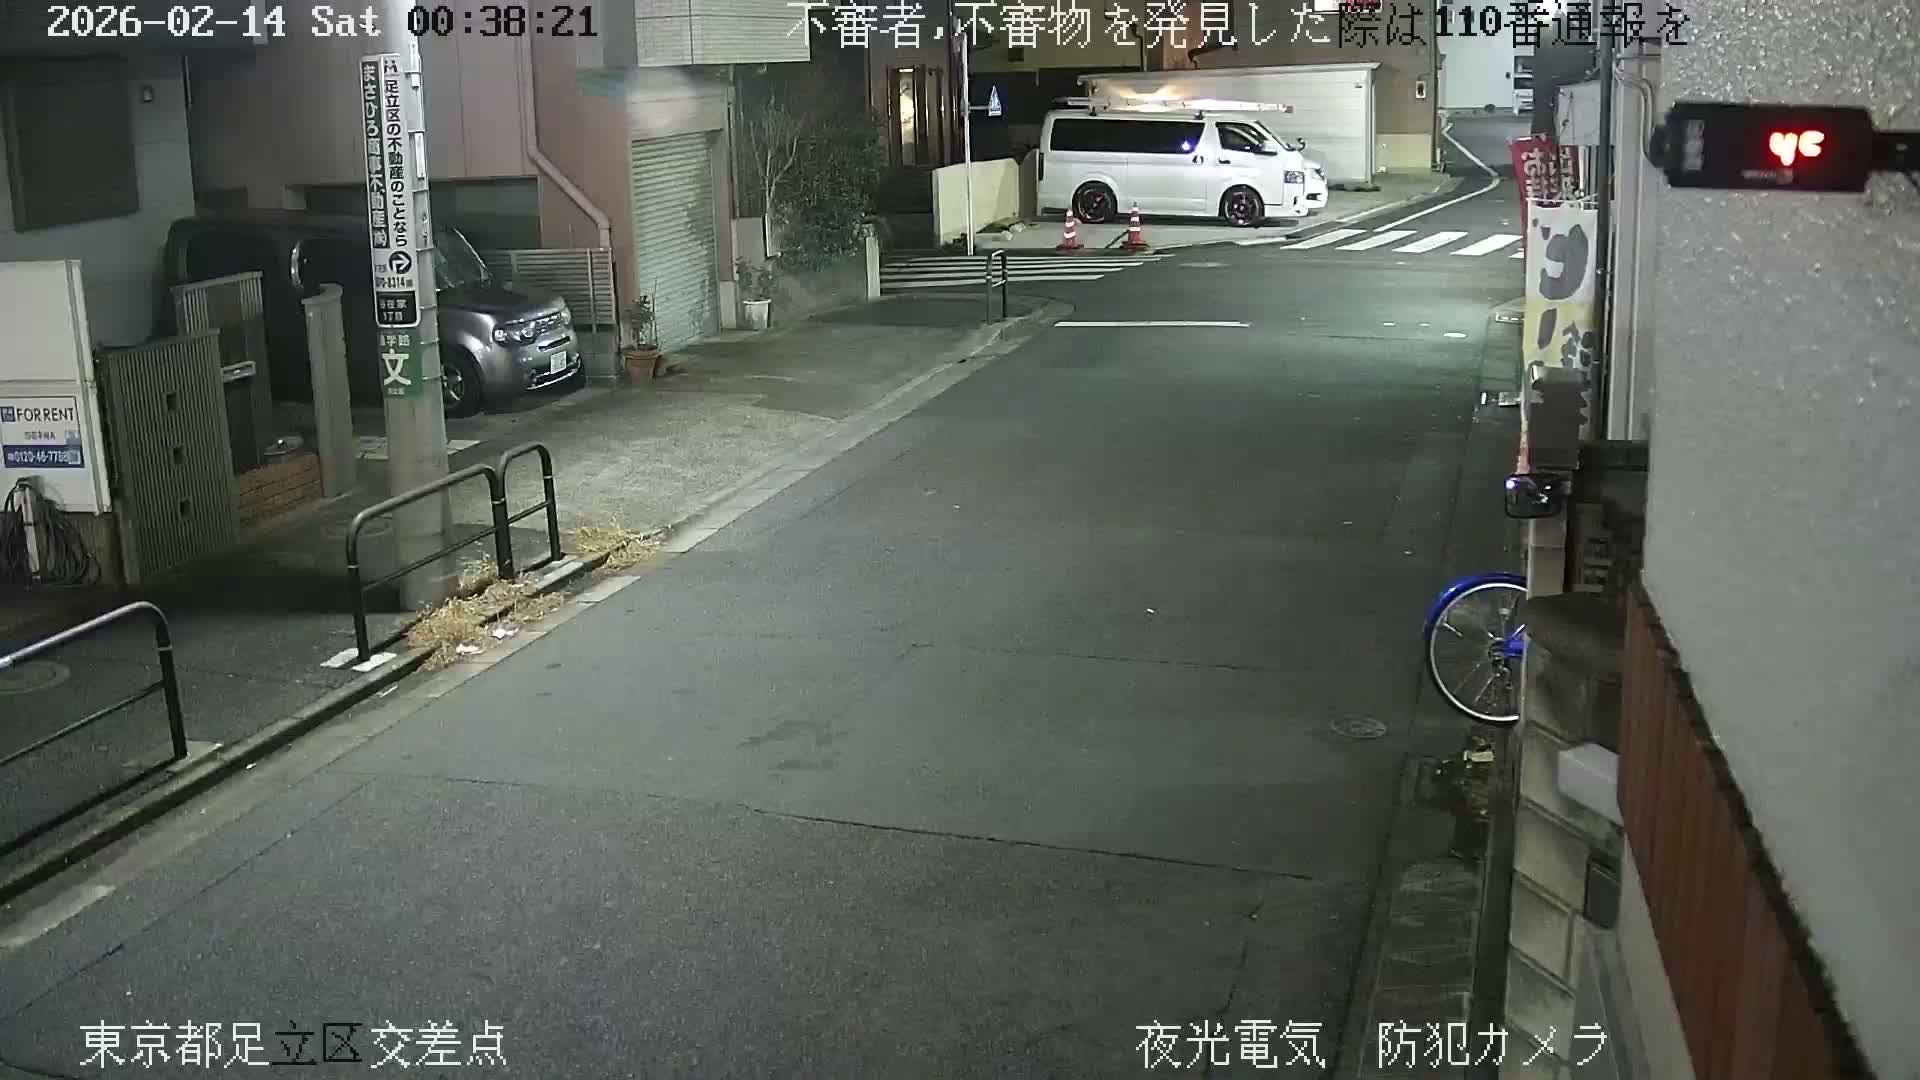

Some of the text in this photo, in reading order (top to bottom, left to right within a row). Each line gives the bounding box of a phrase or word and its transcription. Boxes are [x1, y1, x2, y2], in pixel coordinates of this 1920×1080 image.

[384, 79, 408, 247] 足立区の不動産のことなら
[382, 348, 412, 386] 文
[17, 407, 41, 422] FOR
[43, 407, 74, 422] RENT
